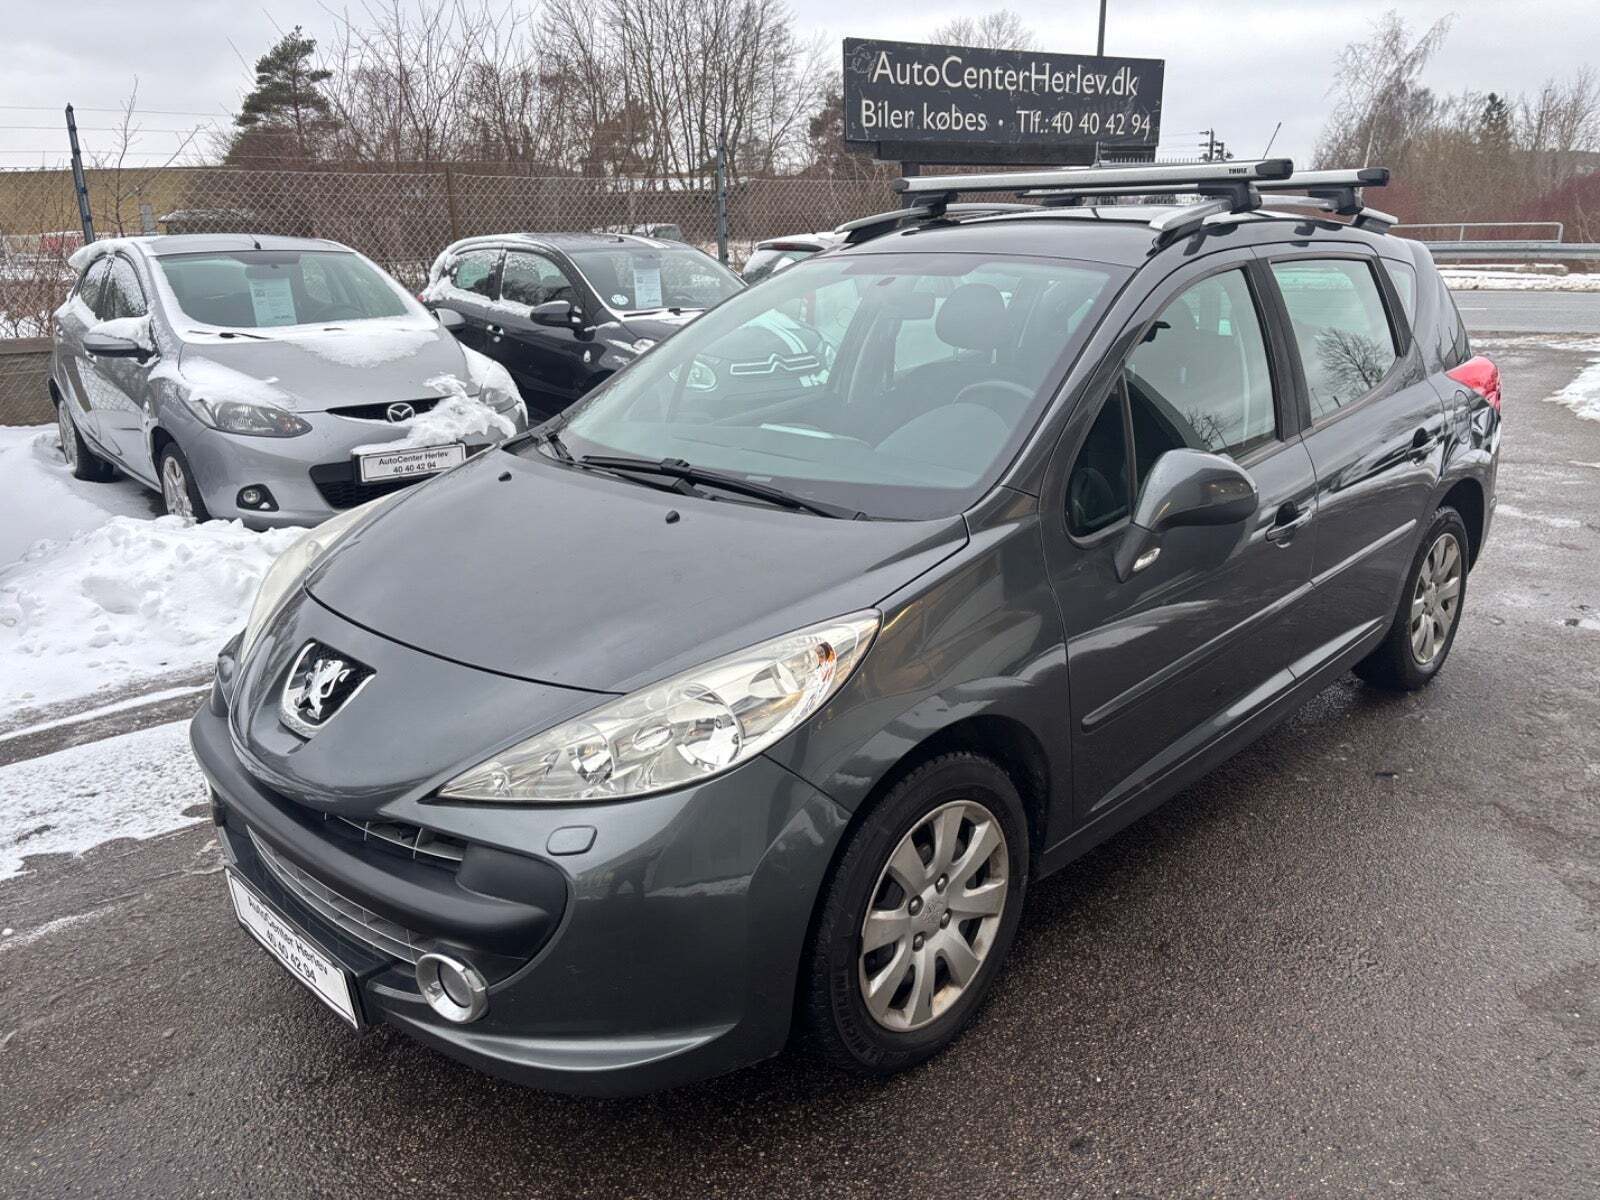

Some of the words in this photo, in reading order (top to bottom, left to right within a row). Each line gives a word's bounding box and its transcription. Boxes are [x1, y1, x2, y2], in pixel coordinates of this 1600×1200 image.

[872, 51, 1138, 97] AutoCenterHerlev.dk
[861, 100, 914, 129] Biler
[923, 102, 987, 131] købes
[1079, 112, 1100, 135] 40
[1105, 113, 1125, 135] 42
[1131, 113, 1151, 141] 94
[379, 454, 423, 466] AutoCenter
[425, 450, 449, 460] Herlev
[427, 461, 437, 469] 94
[290, 953, 302, 971] 42
